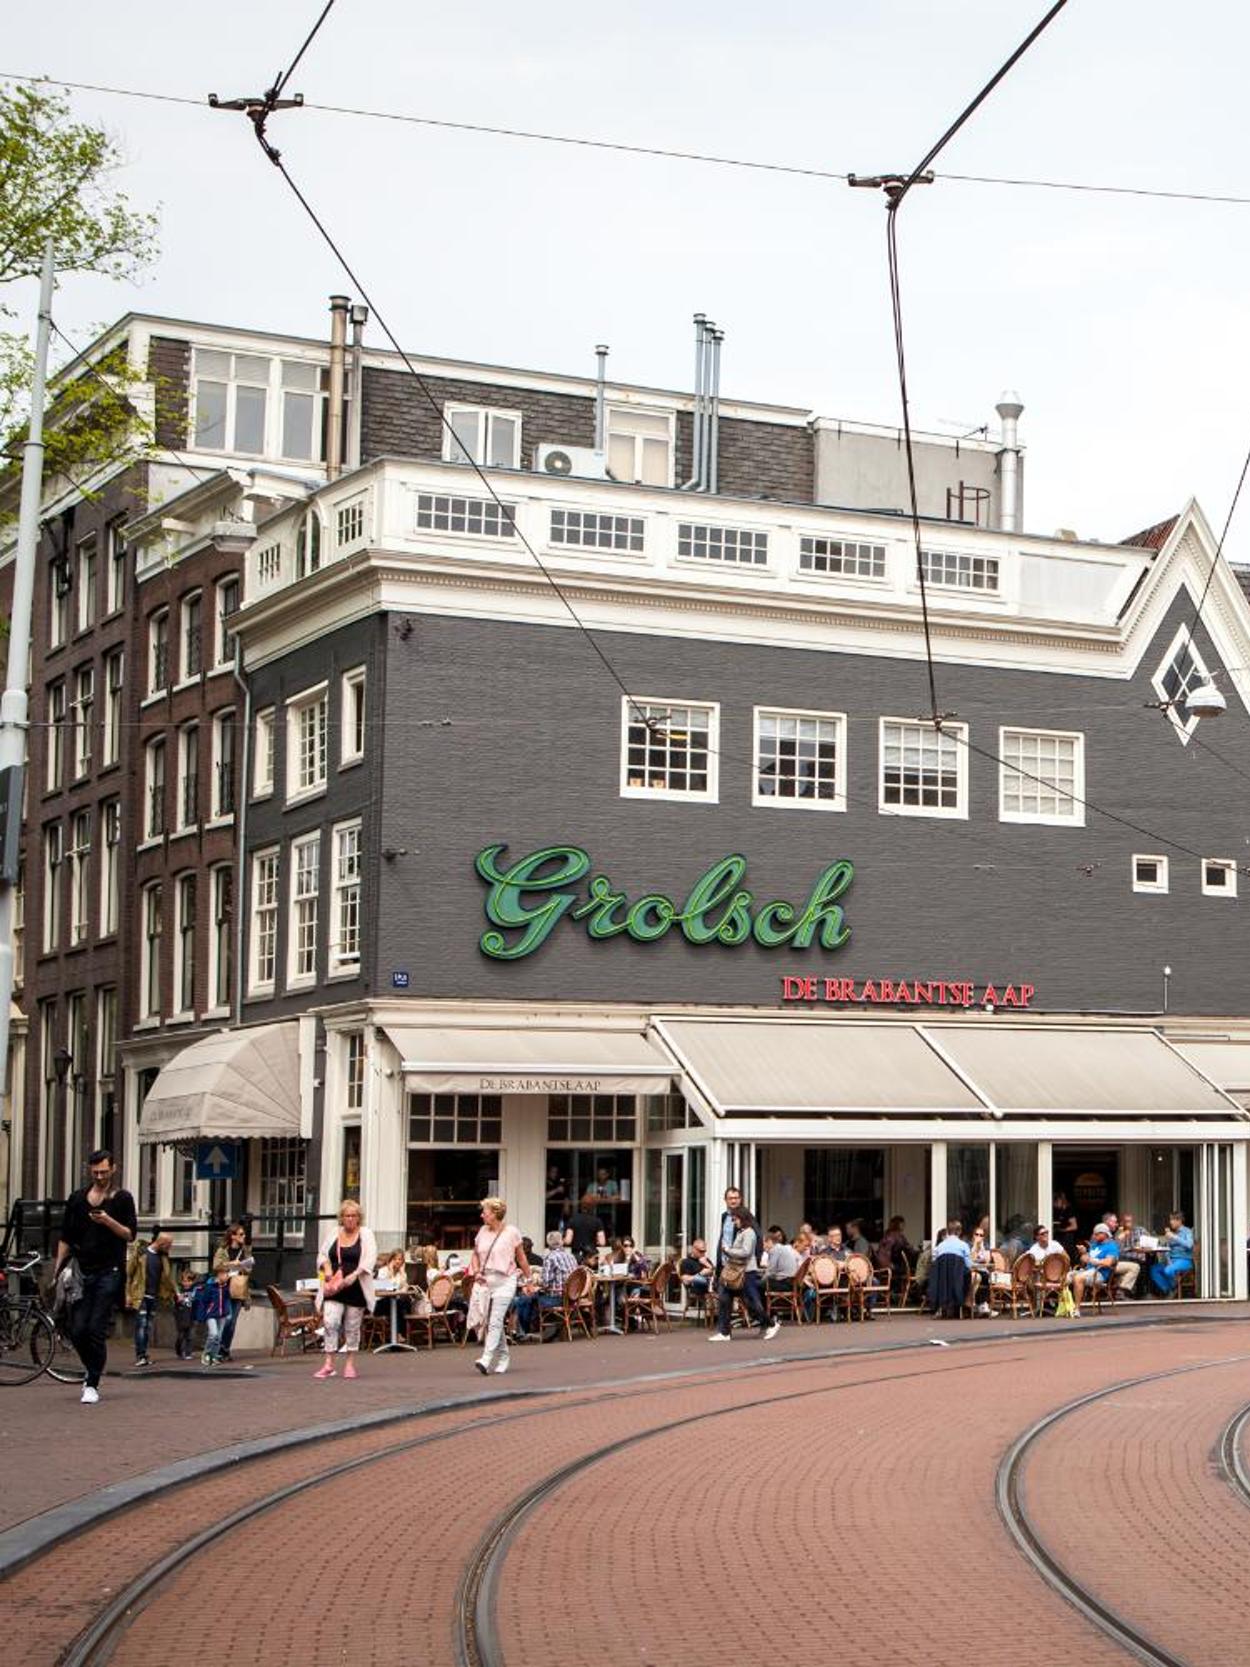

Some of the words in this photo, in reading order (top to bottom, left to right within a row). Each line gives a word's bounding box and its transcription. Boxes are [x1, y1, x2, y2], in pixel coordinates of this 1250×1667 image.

[474, 843, 854, 960] Grolsch
[782, 976, 818, 1001] DE
[824, 977, 975, 1006] BRABANTSE
[981, 982, 1035, 1007] AAP
[480, 1078, 495, 1089] DE
[574, 1080, 600, 1092] AAP
